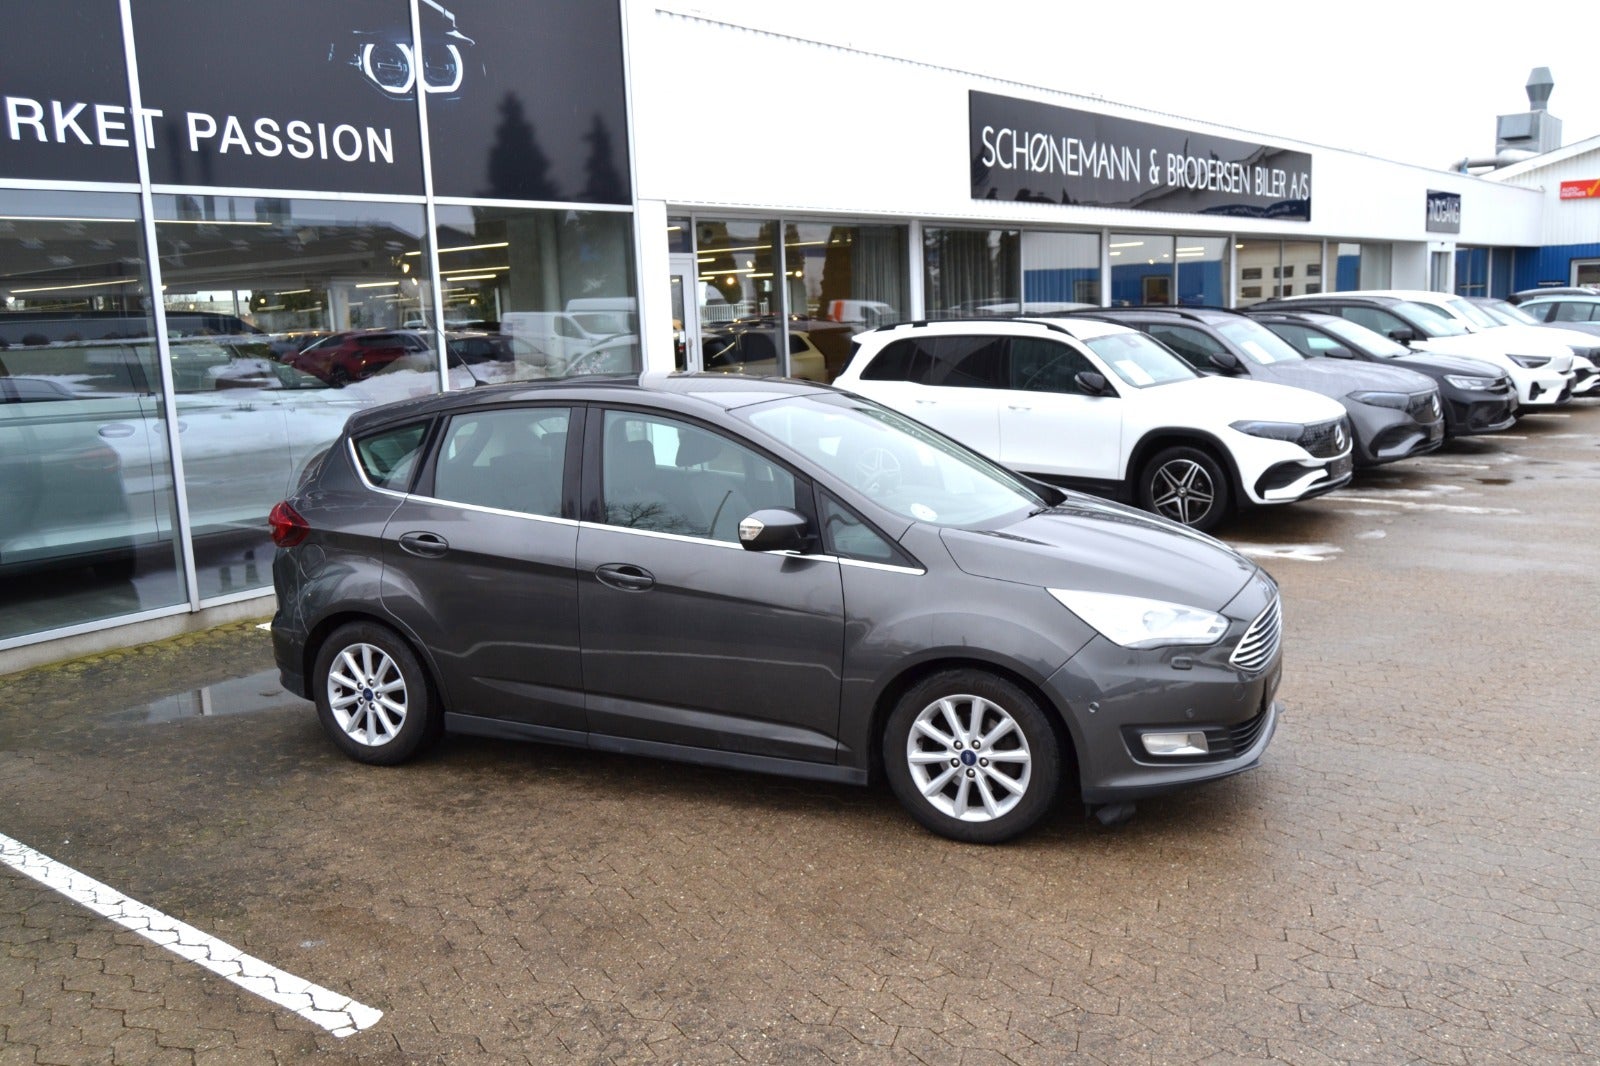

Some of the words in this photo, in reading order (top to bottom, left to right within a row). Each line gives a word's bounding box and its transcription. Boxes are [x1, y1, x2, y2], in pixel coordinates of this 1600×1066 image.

[5, 96, 163, 149] RKET
[186, 112, 394, 164] PASSION
[982, 125, 1141, 184] SCHØNEMANN
[1149, 148, 1160, 185] &
[1167, 152, 1250, 195] BRODERSEN
[1255, 166, 1286, 199] BILER
[1289, 171, 1310, 201] A/S
